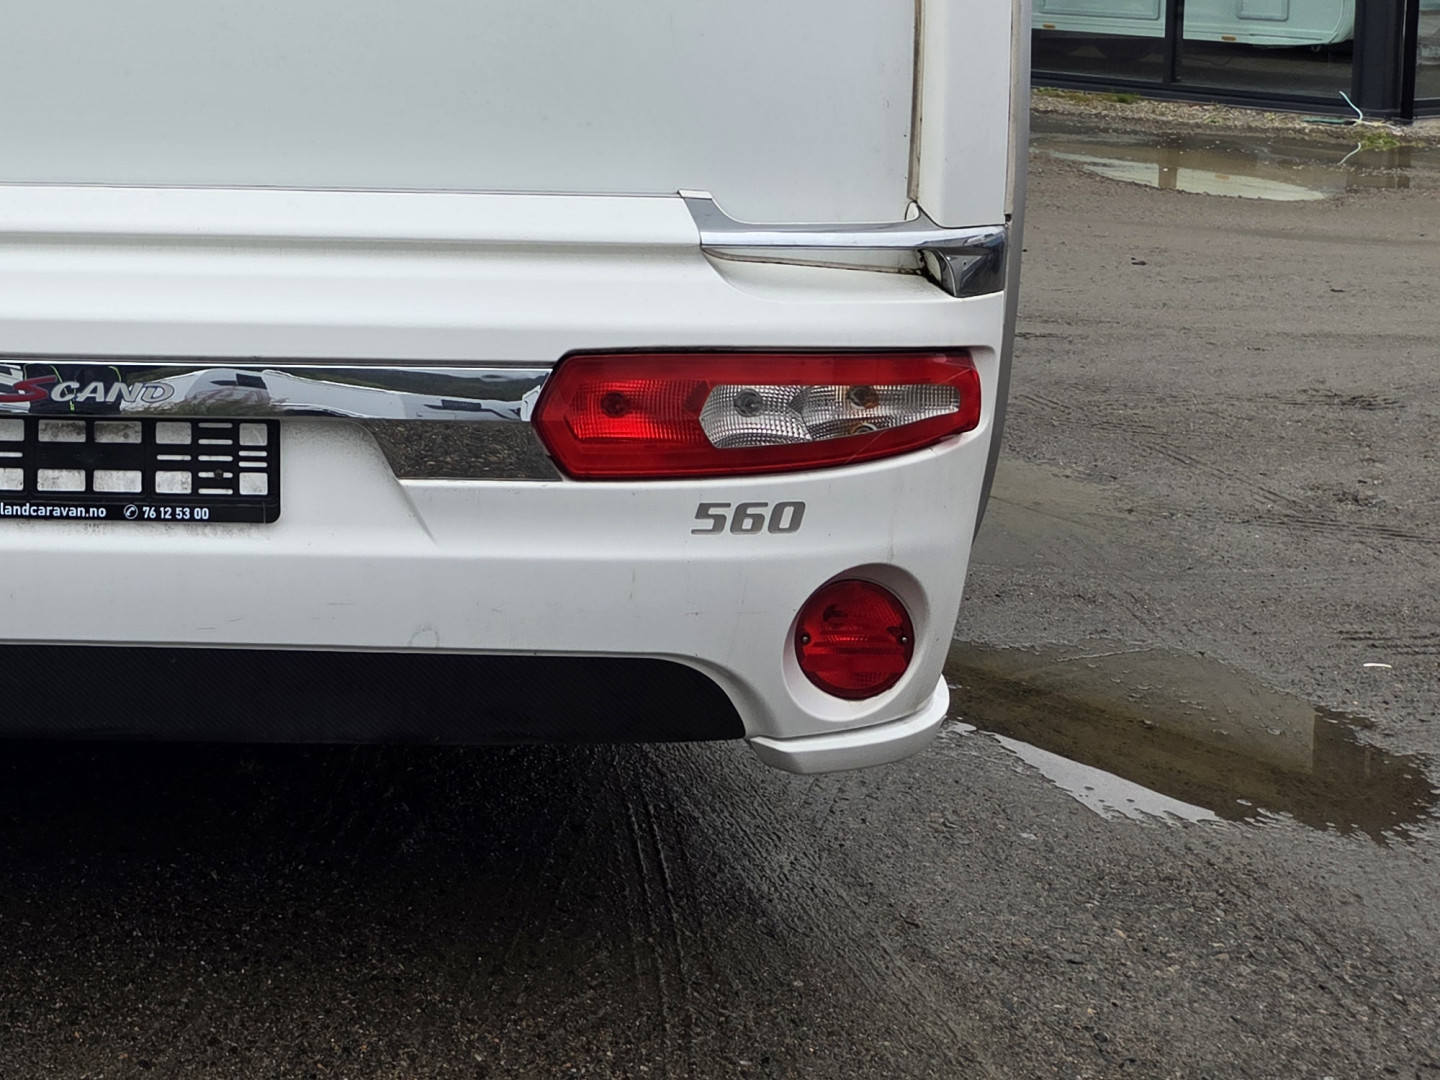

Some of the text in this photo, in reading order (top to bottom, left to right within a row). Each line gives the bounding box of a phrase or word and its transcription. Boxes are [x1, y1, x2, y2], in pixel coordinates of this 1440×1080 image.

[142, 506, 157, 519] 76
[160, 507, 172, 519] 12
[175, 507, 191, 519] 53
[194, 507, 209, 520] 00
[690, 500, 806, 535] 560
